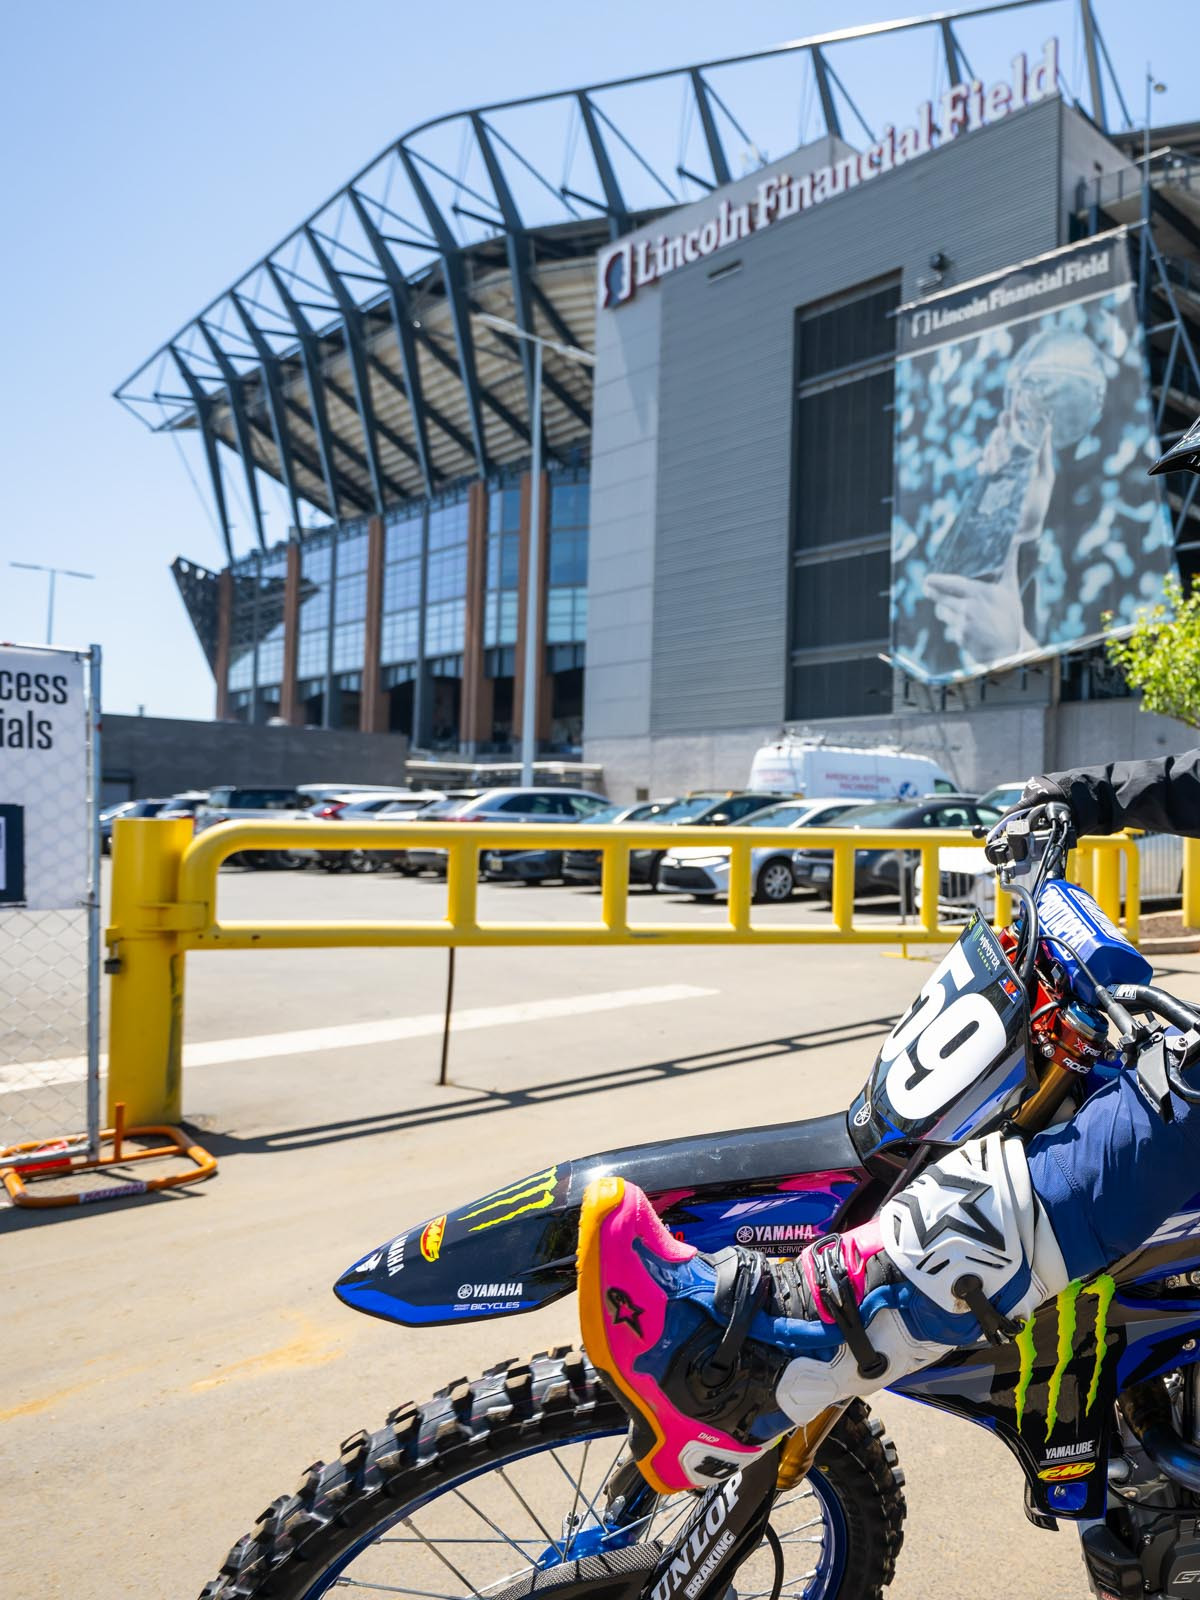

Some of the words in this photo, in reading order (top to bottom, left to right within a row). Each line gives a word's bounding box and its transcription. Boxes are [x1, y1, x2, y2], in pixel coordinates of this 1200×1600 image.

[637, 201, 754, 286] Lincoln
[755, 101, 936, 230] Financial
[938, 36, 1059, 142] Field
[933, 297, 988, 330] Lincoln
[989, 266, 1063, 311] Financial
[1064, 251, 1110, 286] Field
[880, 940, 1007, 1120] 59
[754, 1224, 813, 1242] YAMAHA
[470, 1301, 520, 1311] BICYCLES
[472, 1282, 523, 1297] YAMAHA
[1045, 1441, 1094, 1460] YAMALUBE
[649, 1470, 744, 1600] UNLOP
[685, 1530, 736, 1600] BRAKING
